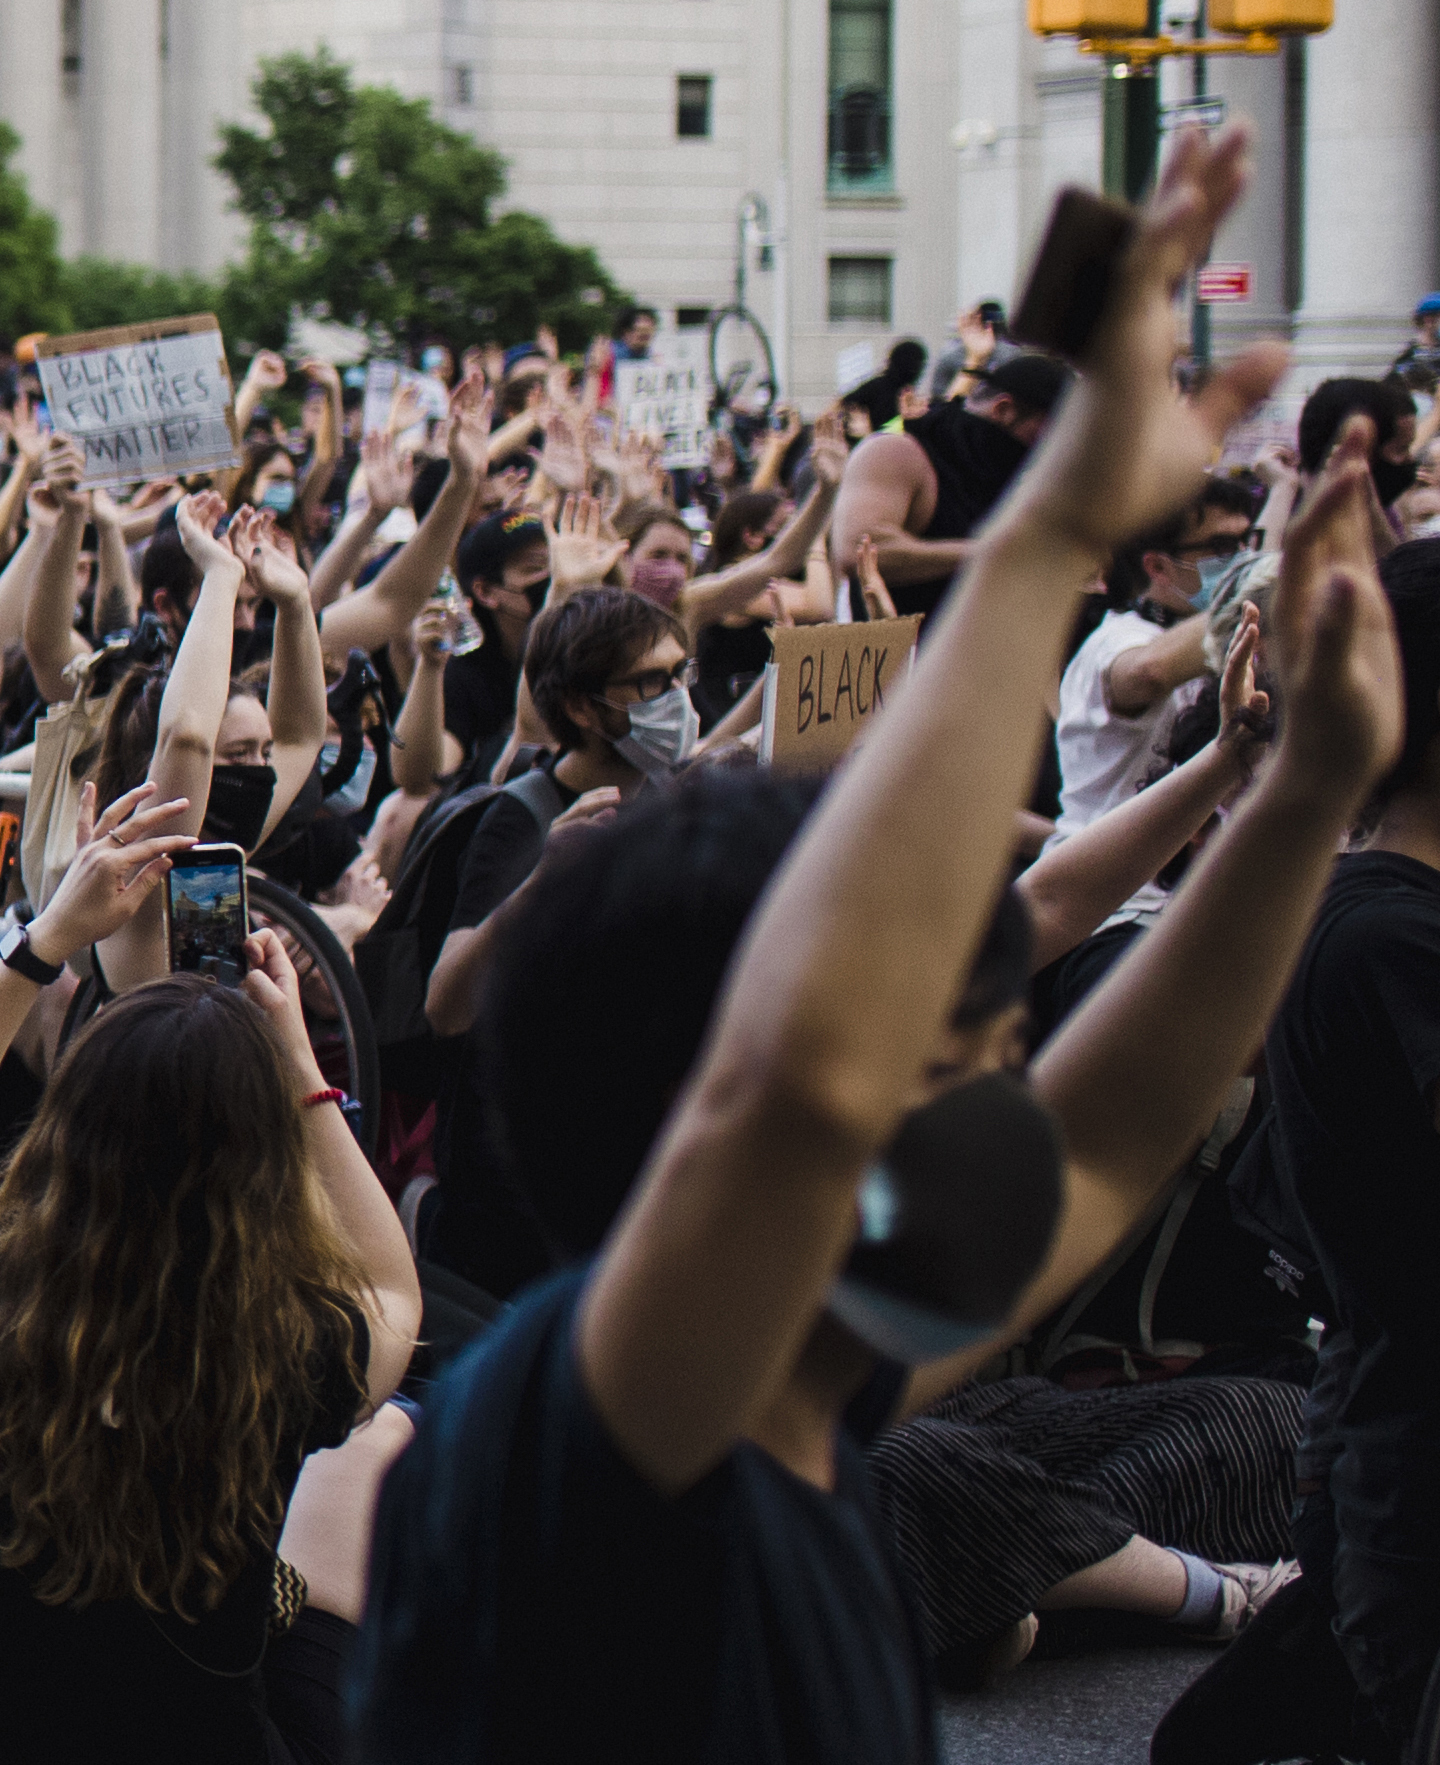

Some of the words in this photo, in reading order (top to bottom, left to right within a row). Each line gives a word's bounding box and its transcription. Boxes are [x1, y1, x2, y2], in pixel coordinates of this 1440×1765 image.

[57, 344, 166, 390] BLACK
[67, 369, 210, 426] FUTURES
[83, 421, 201, 463] MATTER
[797, 645, 888, 735] BLACK
